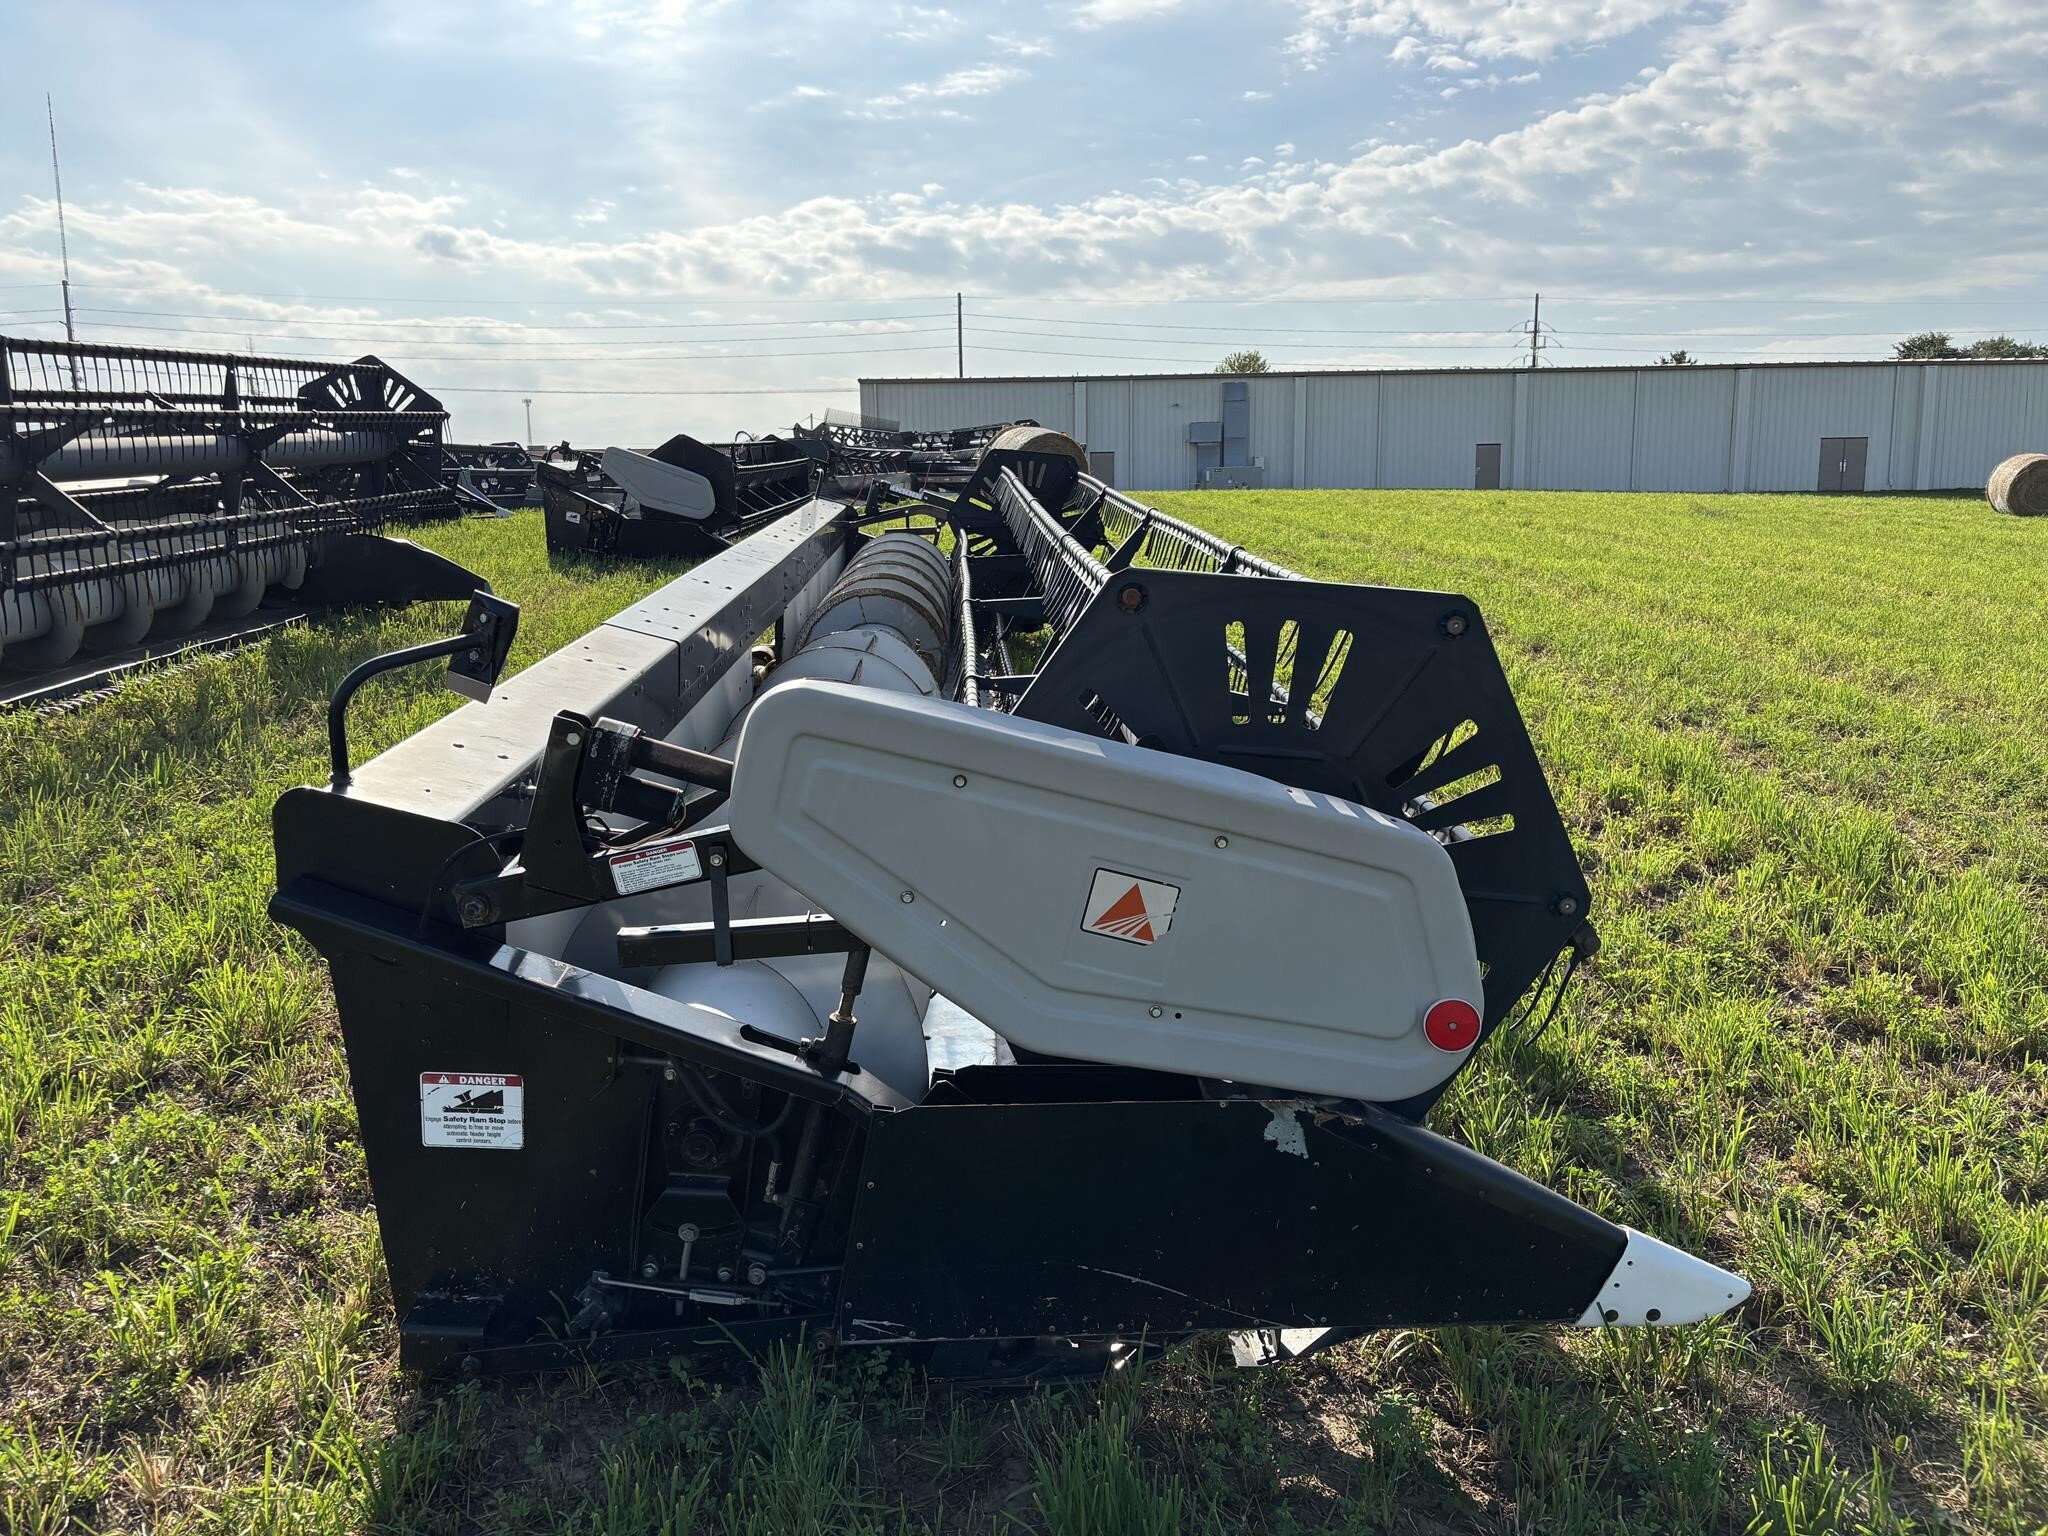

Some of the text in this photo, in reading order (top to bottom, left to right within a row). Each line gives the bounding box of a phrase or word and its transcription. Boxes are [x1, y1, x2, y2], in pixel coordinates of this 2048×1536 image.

[646, 848, 667, 856] DANGER
[459, 1076, 506, 1085] DANGER
[443, 1115, 468, 1124] Safety
